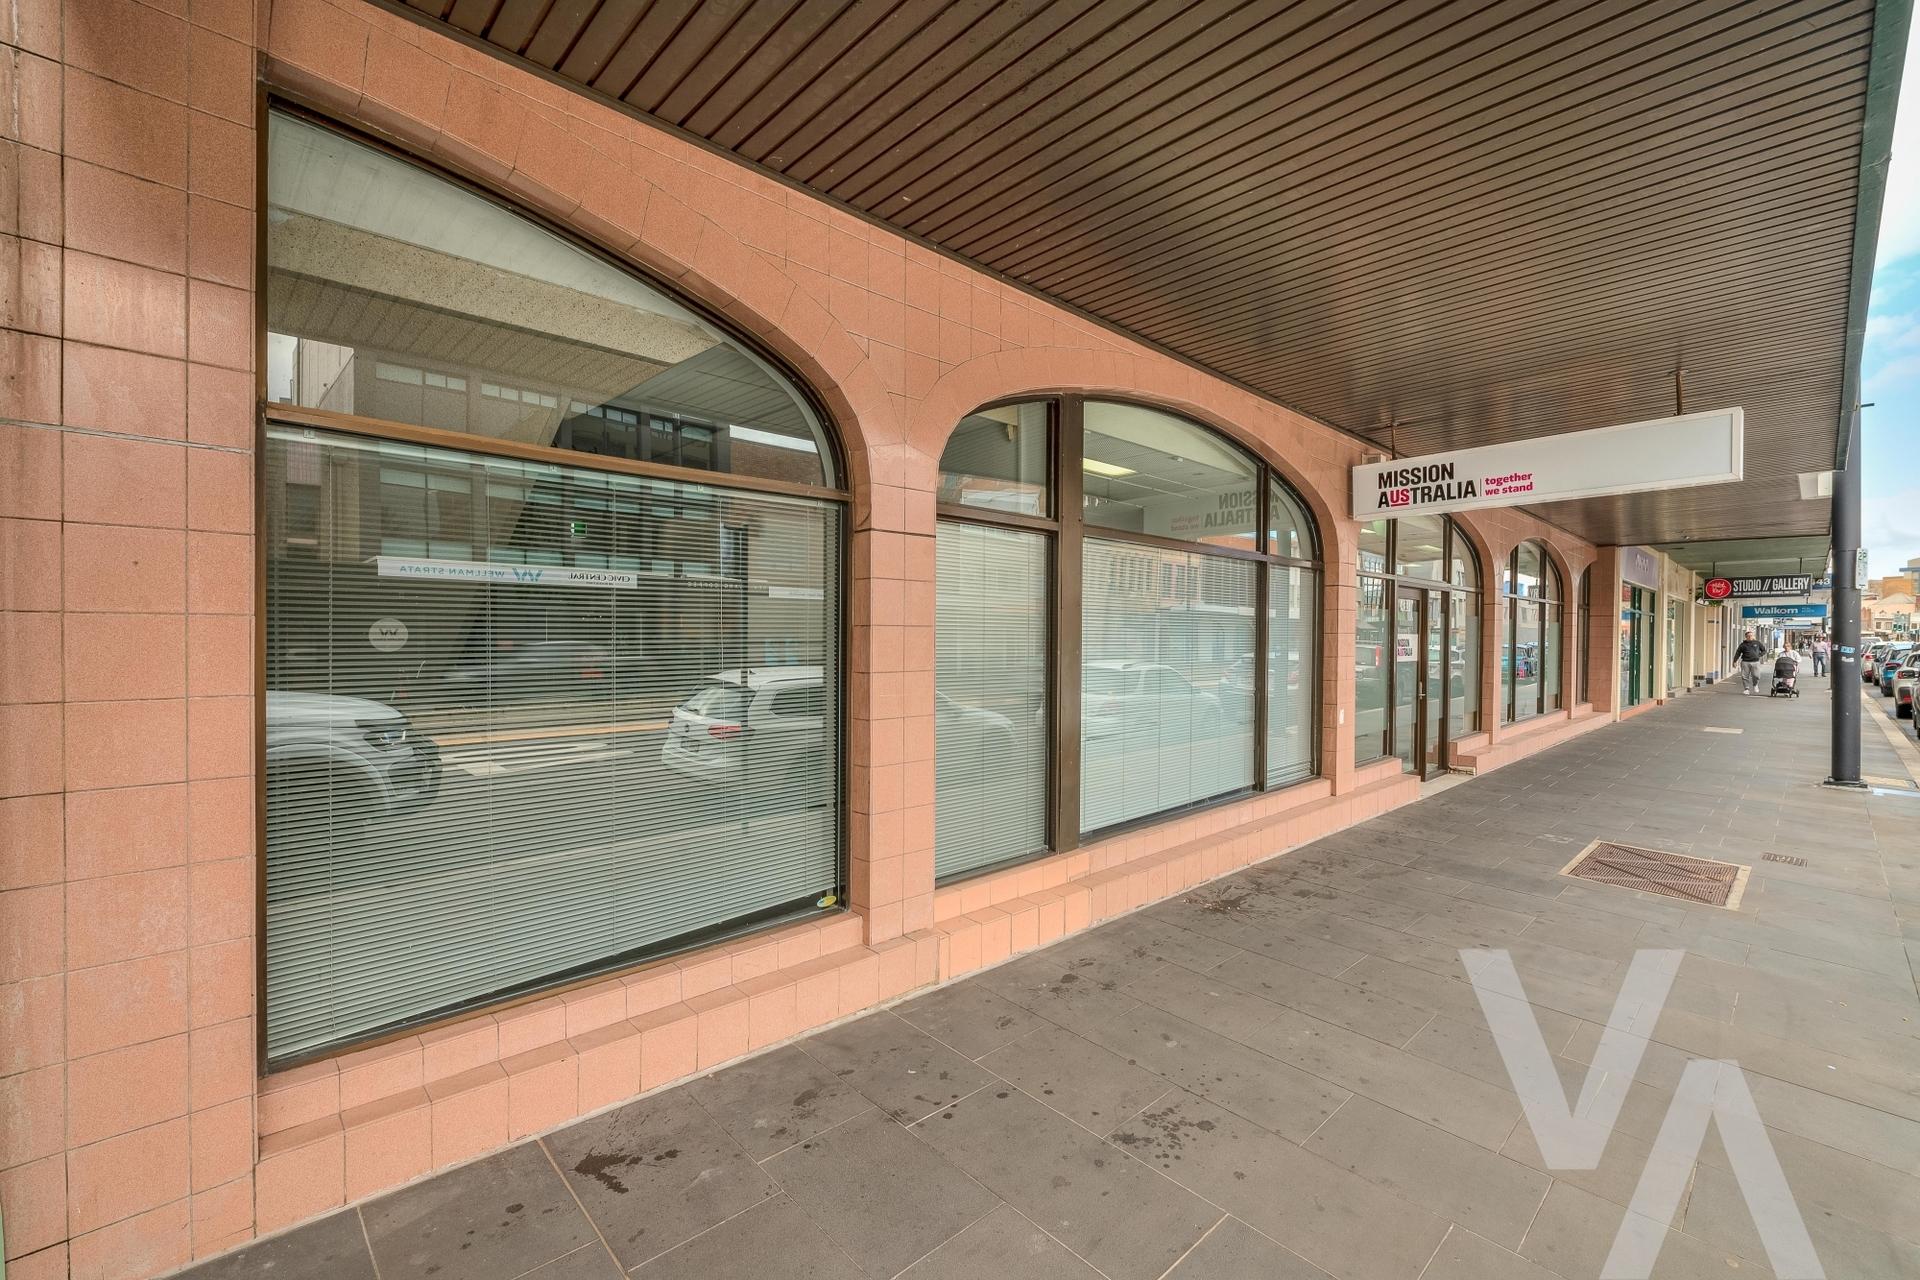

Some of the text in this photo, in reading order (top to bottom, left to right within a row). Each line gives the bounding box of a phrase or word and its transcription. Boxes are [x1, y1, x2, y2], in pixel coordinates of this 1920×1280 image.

[1378, 462, 1454, 489] MISSION
[1484, 472, 1533, 487] together
[1377, 480, 1477, 508] AUSTRALIA
[1484, 482, 1534, 496] we stand
[1733, 579, 1761, 592] STUDIO
[1772, 577, 1810, 590] GALLERY
[1754, 607, 1799, 615] Walkom
